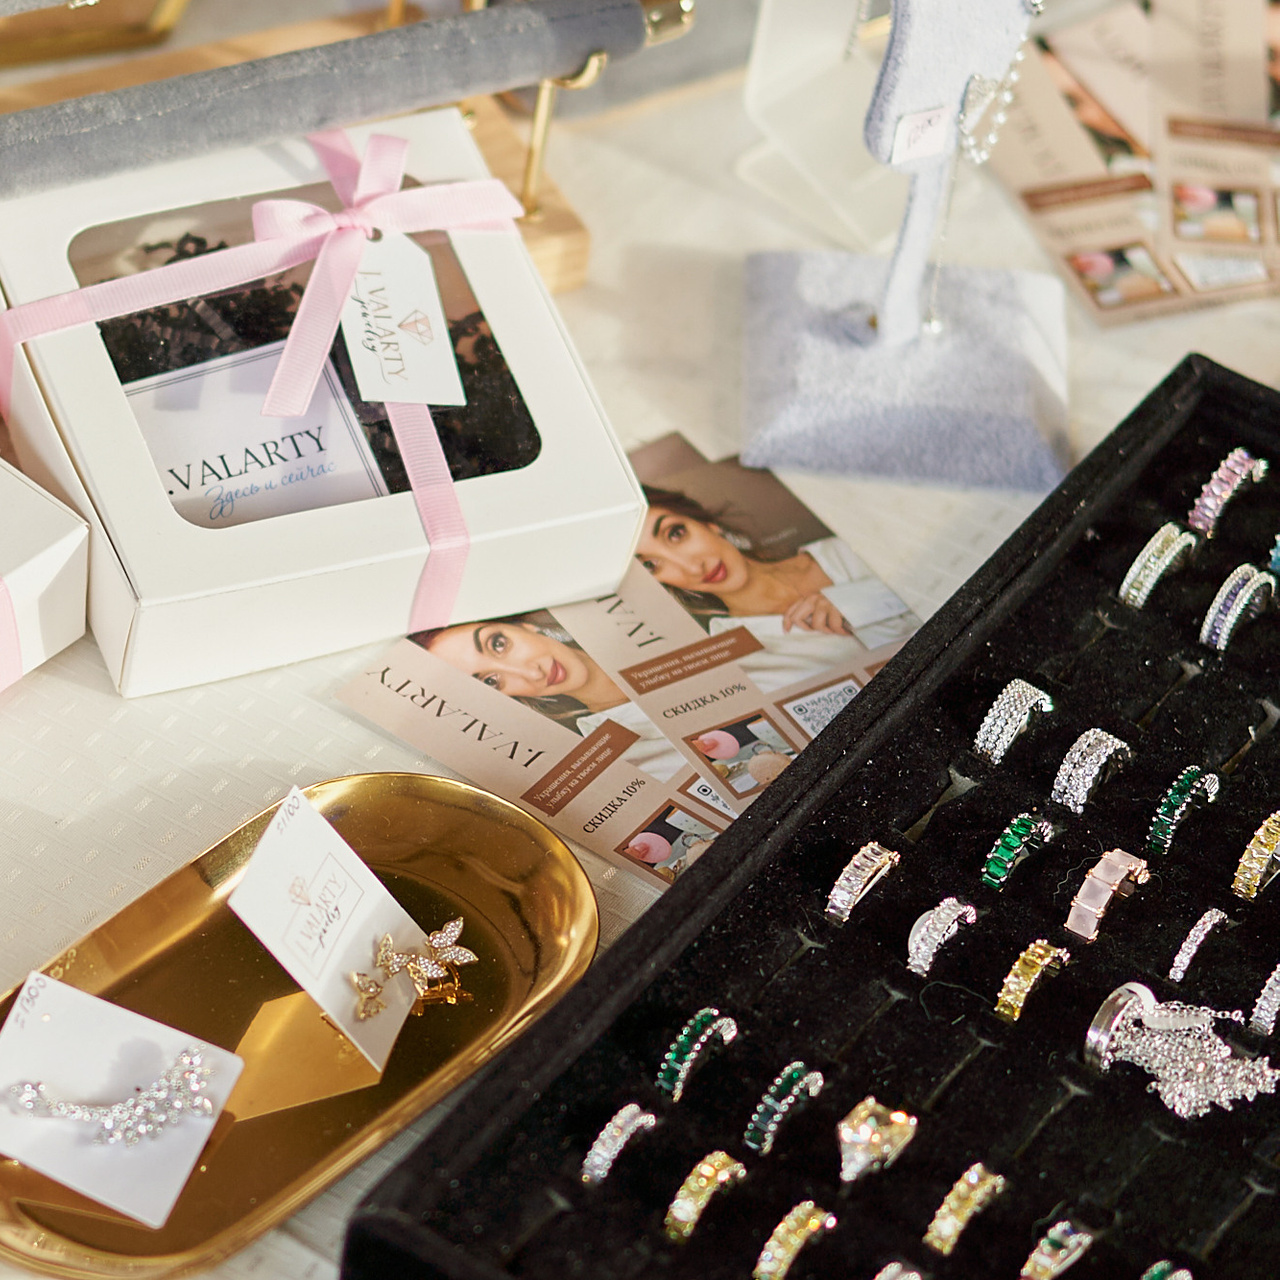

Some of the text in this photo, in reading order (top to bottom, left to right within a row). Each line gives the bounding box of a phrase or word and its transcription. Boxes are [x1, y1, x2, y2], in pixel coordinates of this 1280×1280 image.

[369, 287, 409, 381] VALARTY
[204, 461, 339, 521] Здесь и сейчас
[662, 682, 747, 720] СКИДКА 10%
[582, 777, 646, 835] СКИДКА 10%
